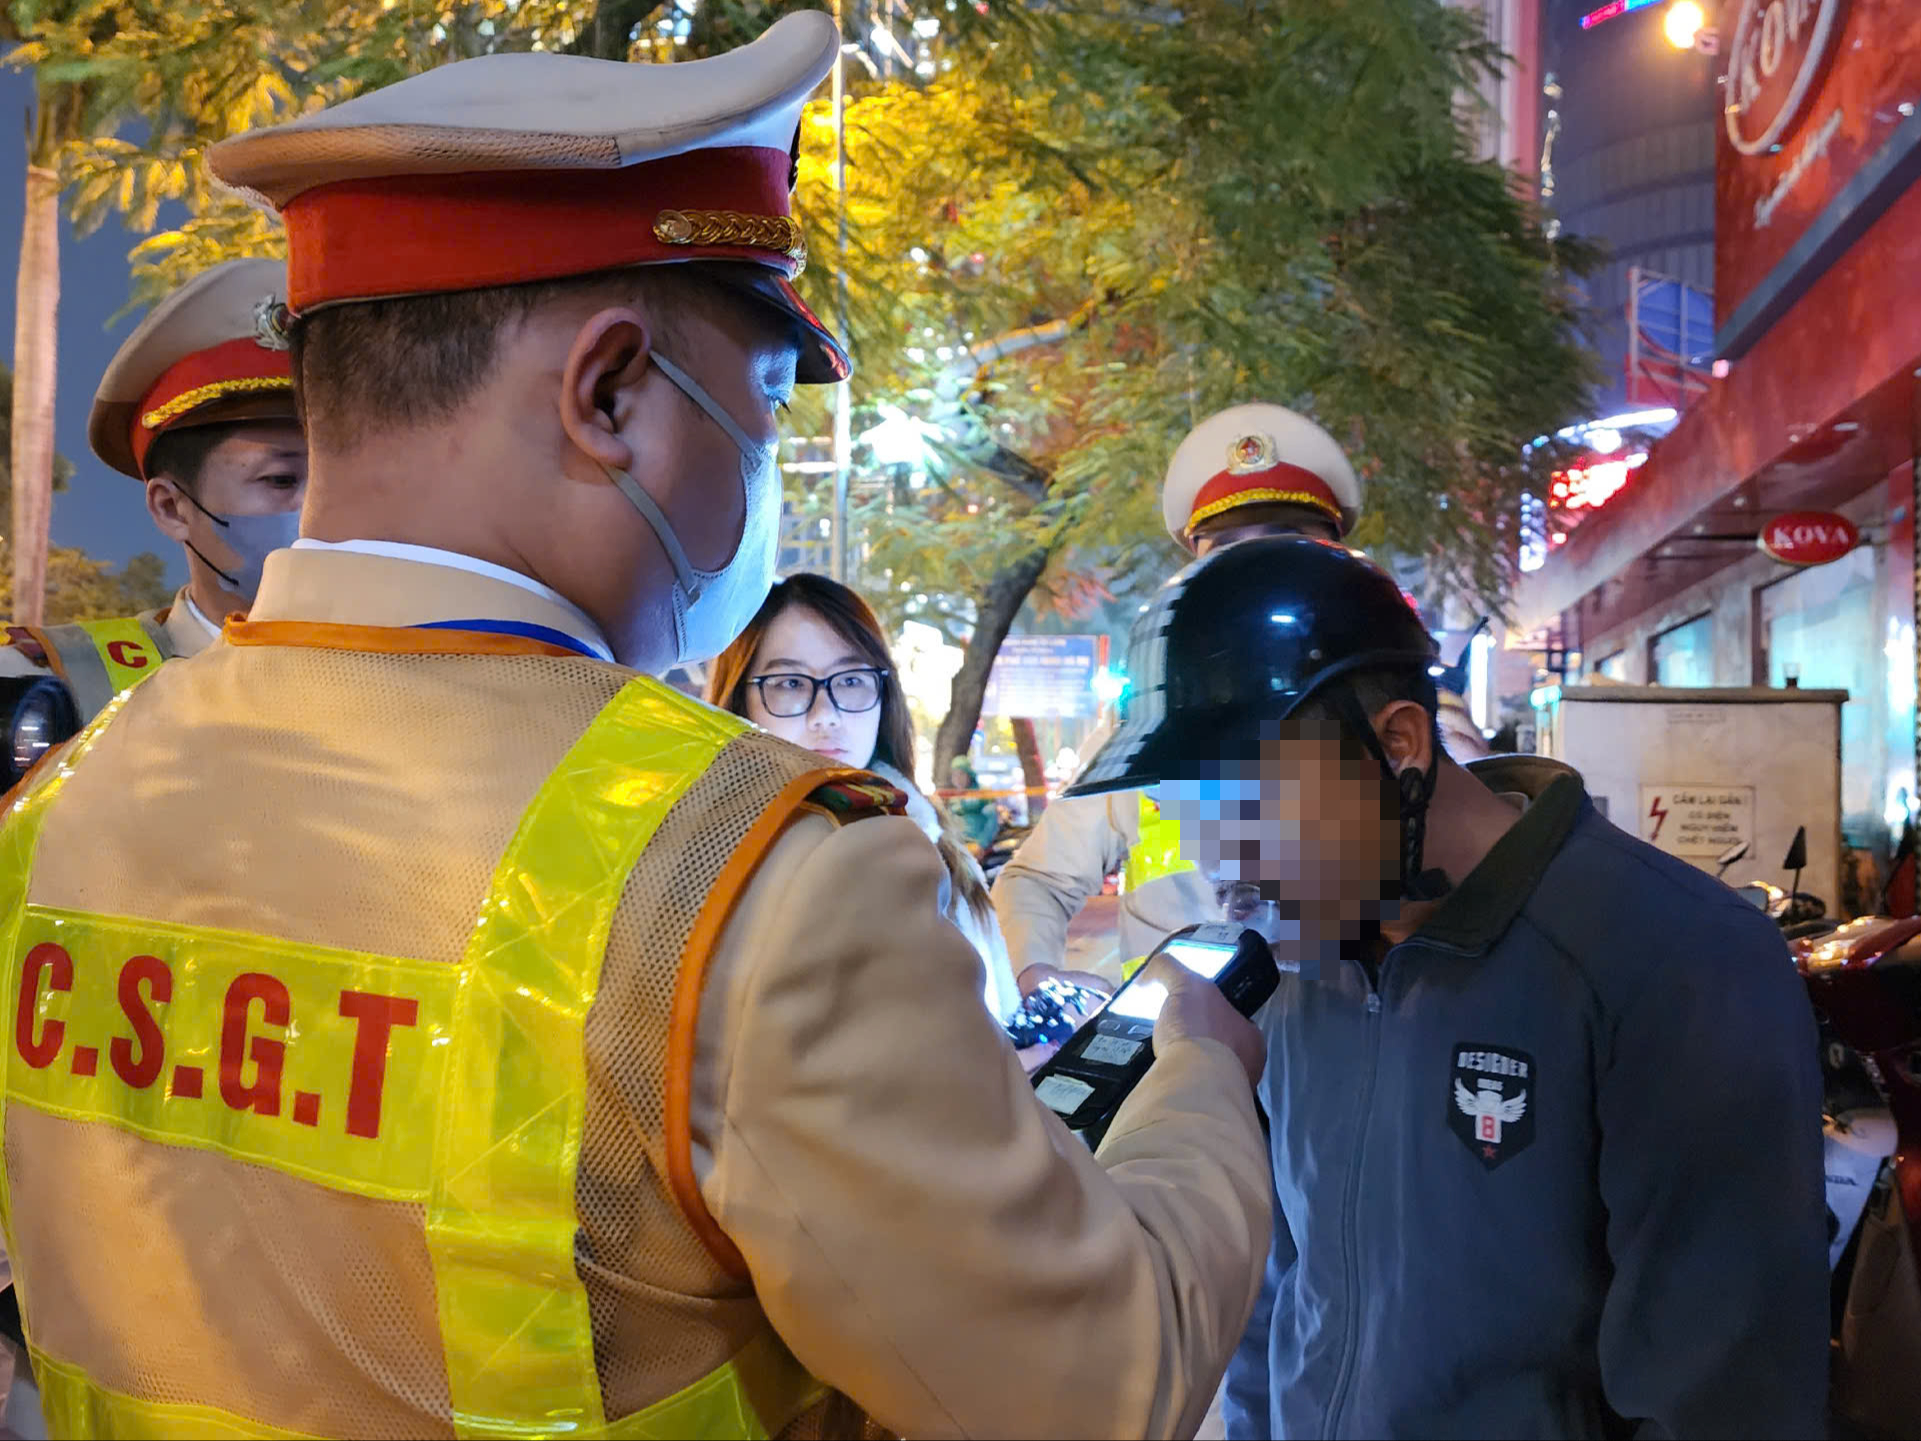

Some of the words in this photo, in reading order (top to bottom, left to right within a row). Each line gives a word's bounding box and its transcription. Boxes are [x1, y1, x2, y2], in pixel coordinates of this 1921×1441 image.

[1738, 0, 1816, 114] KOV
[1773, 525, 1849, 549] KOVA
[106, 640, 148, 669] C
[15, 941, 419, 1139] C.S.G.T
